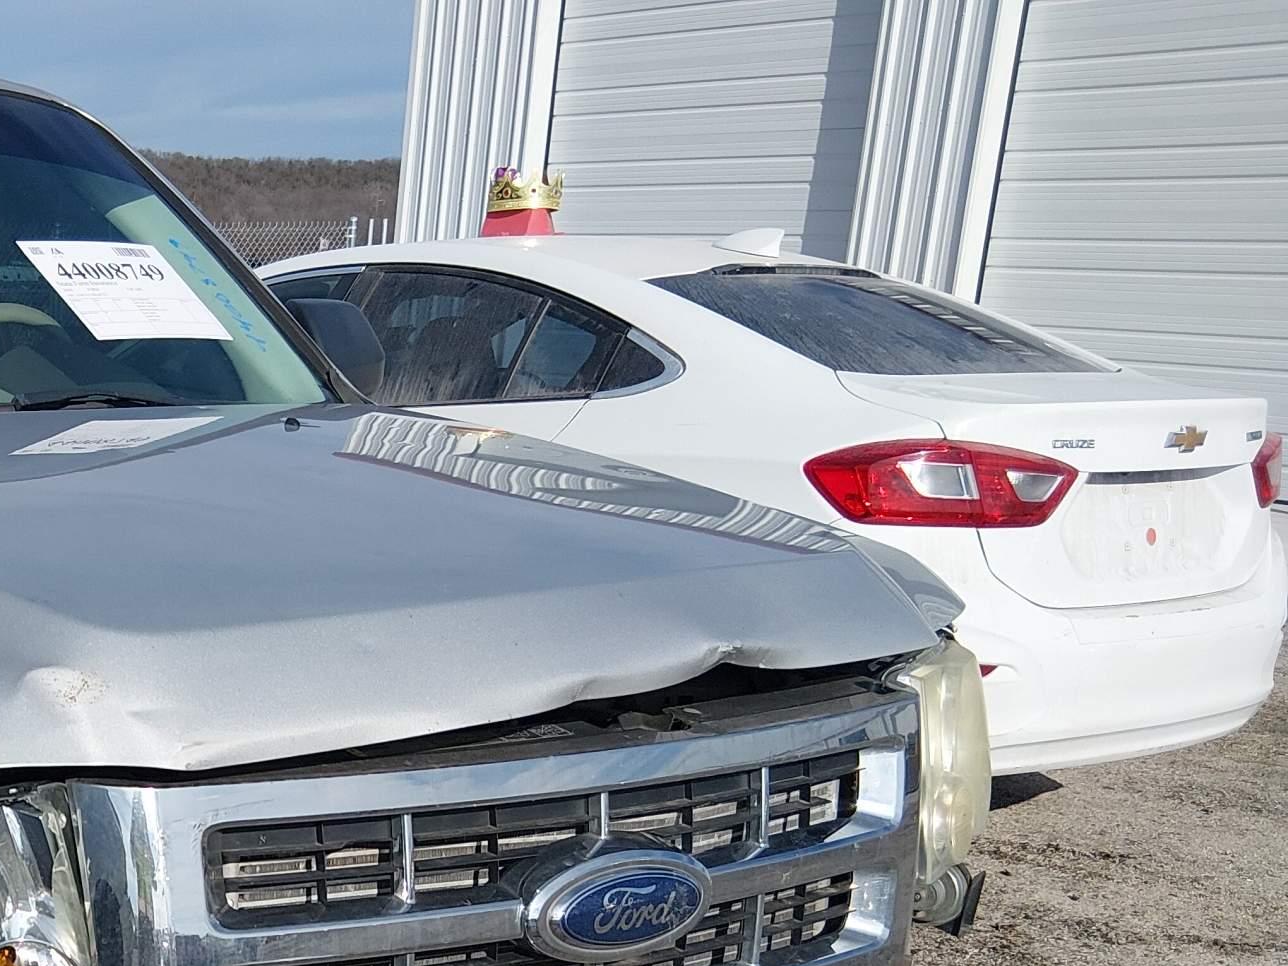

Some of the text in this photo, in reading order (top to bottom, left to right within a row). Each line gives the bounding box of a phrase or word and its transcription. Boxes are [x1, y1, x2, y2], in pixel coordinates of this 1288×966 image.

[57, 262, 165, 281] 44008749
[1052, 439, 1095, 449] CRUZE
[594, 884, 678, 935] Ford
